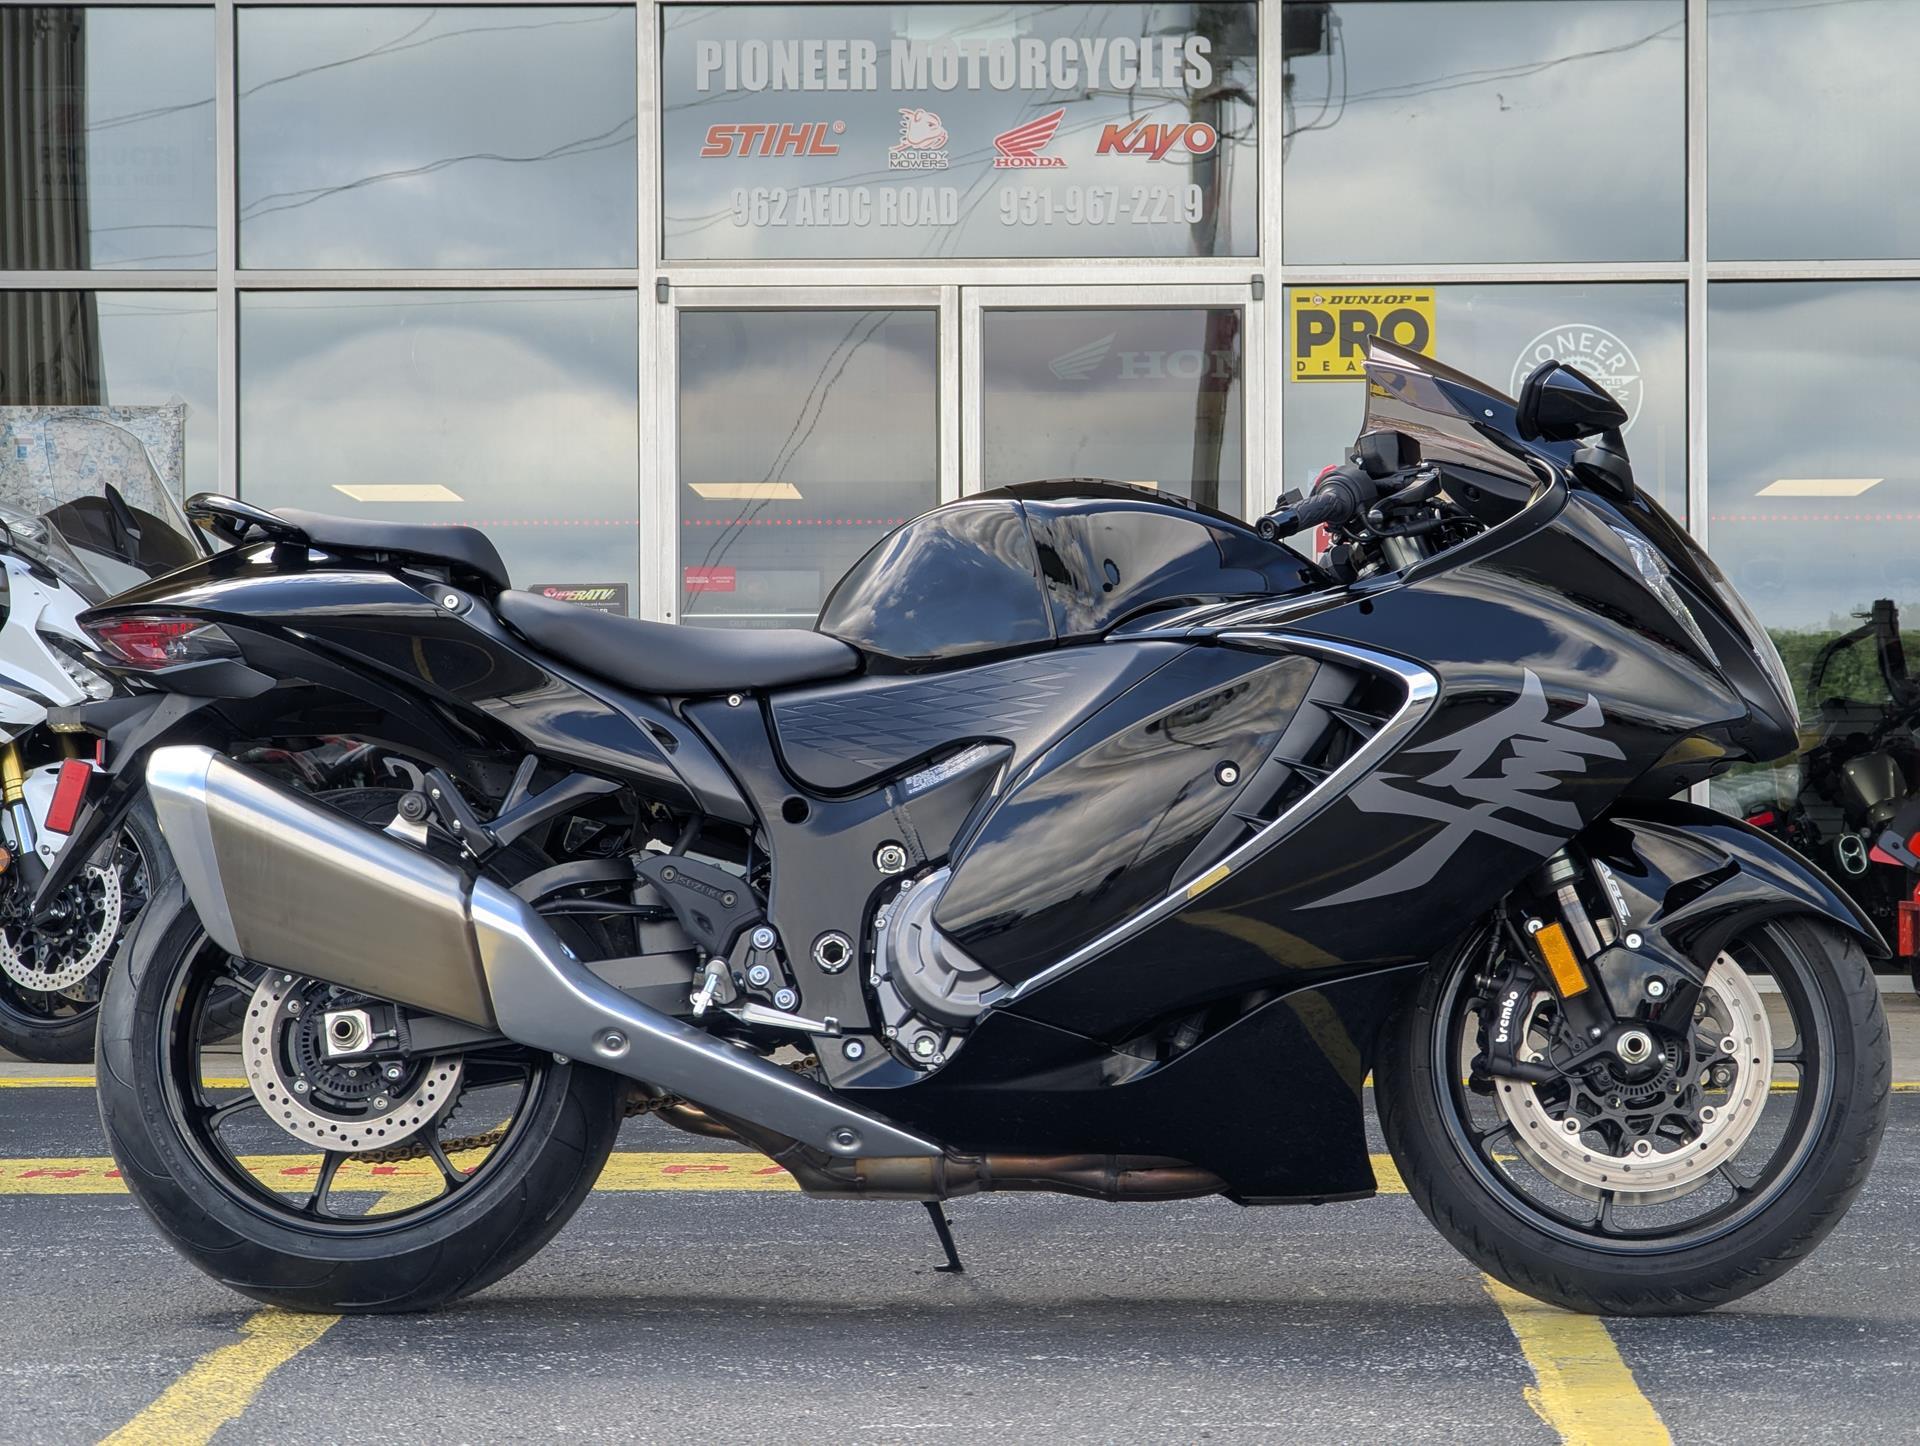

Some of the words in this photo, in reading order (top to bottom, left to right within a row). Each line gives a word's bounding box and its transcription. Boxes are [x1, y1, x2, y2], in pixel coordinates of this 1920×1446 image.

[697, 39, 877, 92] PIONEER
[890, 36, 1213, 91] MOTORCYCLES
[1096, 112, 1217, 162] KAYO
[889, 151, 916, 160] BAD
[919, 151, 949, 160] BOY
[889, 159, 948, 168] MOWERS
[995, 157, 1067, 168] HONDA
[731, 188, 788, 227] 962
[794, 187, 872, 226] AEDC
[880, 186, 959, 226] ROAD
[999, 184, 1203, 226] 931-967-2219
[1328, 295, 1414, 305] DUNLOP
[1296, 308, 1430, 359] PRO
[1117, 349, 1240, 380] HON
[1297, 361, 1357, 372] DEA
[1495, 991, 1519, 1043] brembo
